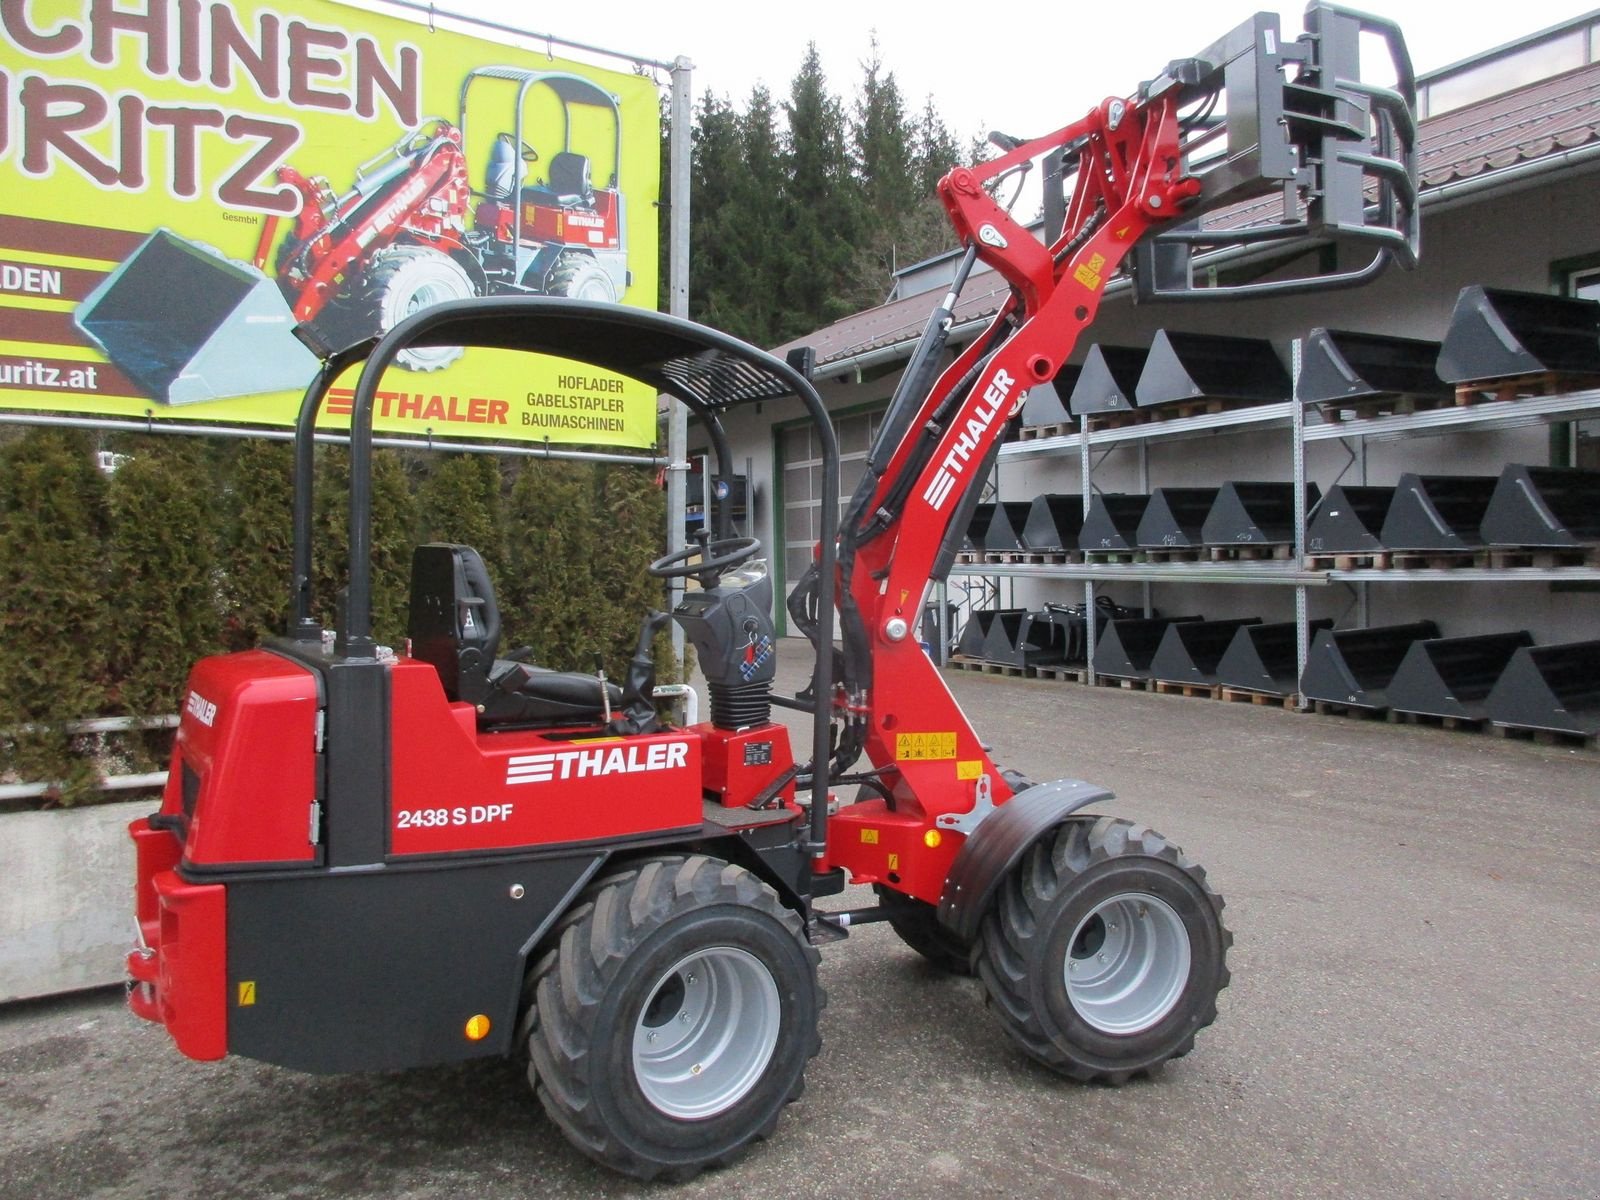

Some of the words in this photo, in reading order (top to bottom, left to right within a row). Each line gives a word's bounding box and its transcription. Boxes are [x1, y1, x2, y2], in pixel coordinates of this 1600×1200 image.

[0, 70, 300, 212] RITZ
[222, 212, 258, 225] GesmbH
[0, 265, 61, 294] DEN
[0, 360, 97, 389] uritz.at
[558, 375, 624, 393] HOFLADER
[373, 391, 509, 425] THALER
[527, 392, 624, 412] GABELSTAPLER
[521, 412, 624, 432] BAUMASCHINEN
[942, 368, 1016, 473] THALER
[193, 694, 217, 727] THALER
[556, 742, 688, 779] THALER
[397, 808, 448, 828] 2438
[452, 807, 467, 826] S
[471, 804, 513, 824] DPF
